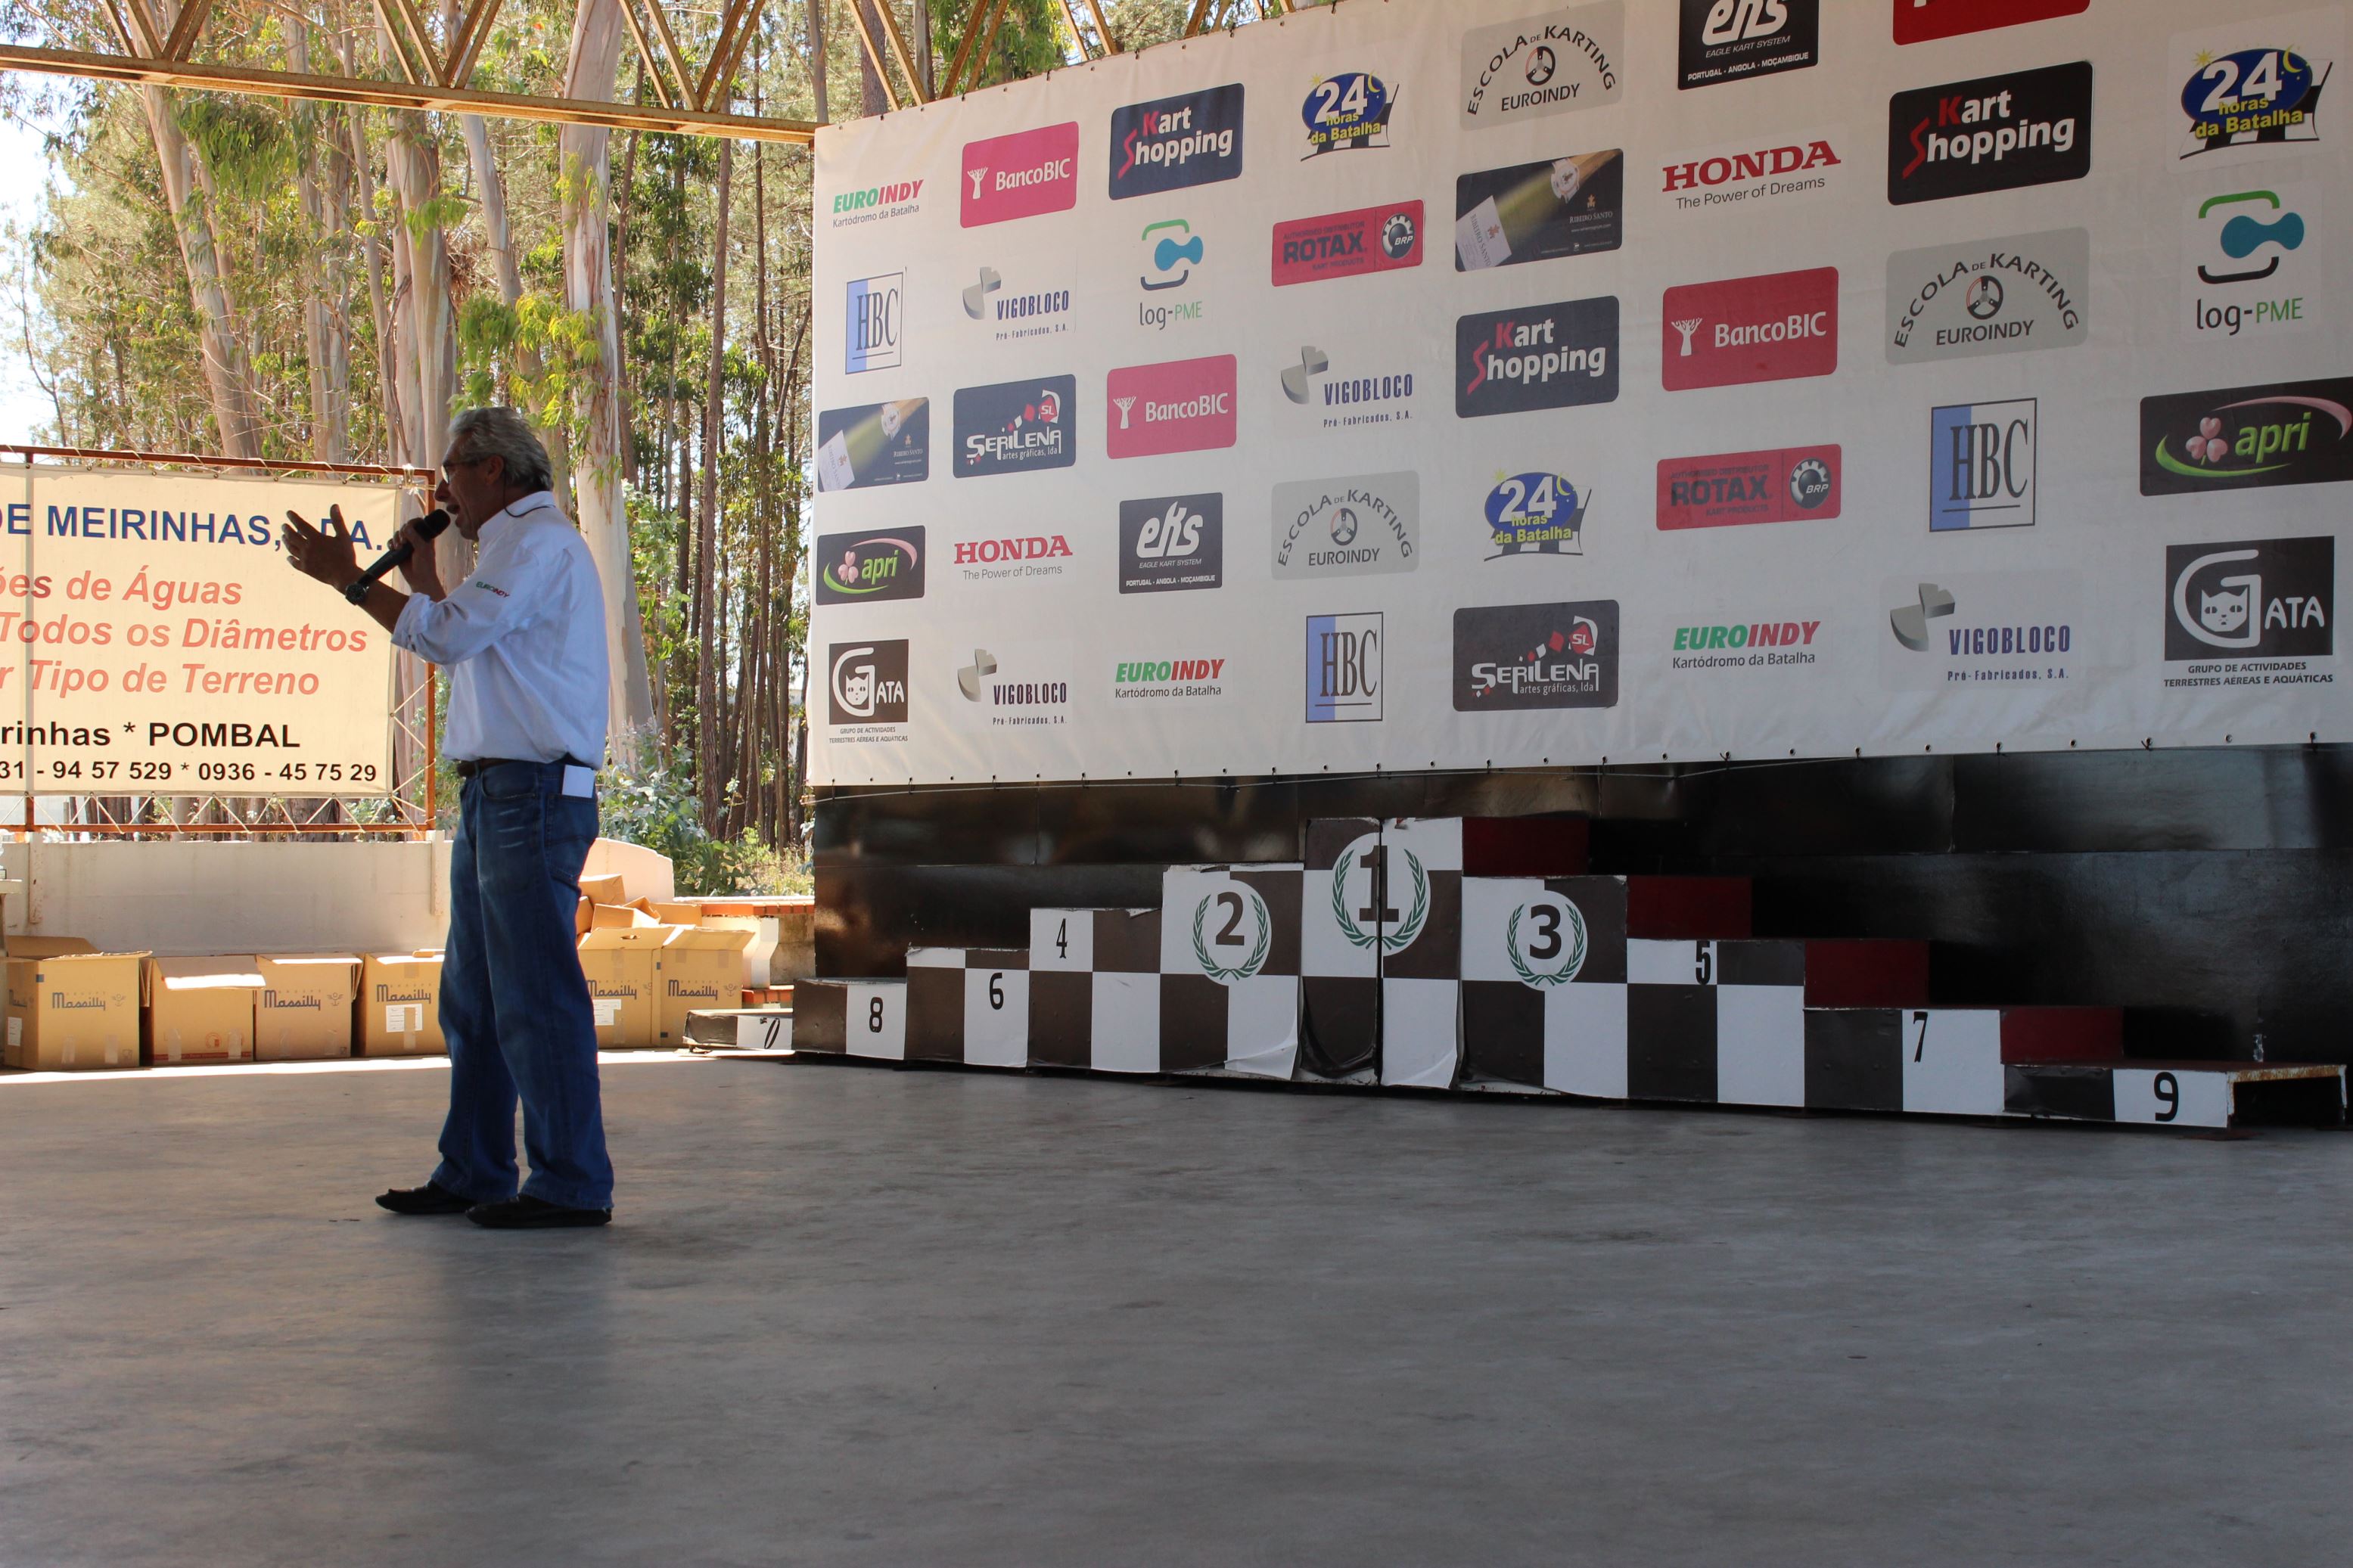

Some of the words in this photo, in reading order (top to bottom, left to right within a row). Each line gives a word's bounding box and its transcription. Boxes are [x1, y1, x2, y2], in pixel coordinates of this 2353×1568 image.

[1706, 47, 1731, 58] EAGLE
[1733, 43, 1754, 53] KART
[1757, 36, 1791, 48] SYSTEM
[1468, 35, 1528, 115] ESCOLA
[1531, 35, 1541, 43] DE
[1544, 25, 1616, 91] KARTING
[1688, 70, 1722, 81] PORTUGAL
[1728, 63, 1755, 73] ANGOLA
[2200, 51, 2282, 112] 24
[1314, 76, 1368, 123] 24
[1501, 83, 1581, 111] EUROINDY
[1938, 89, 2011, 127] Kart
[2218, 98, 2269, 115] horas
[1143, 106, 1192, 136] Kart
[1310, 131, 1326, 144] da
[1331, 121, 1381, 140] Batalha
[1326, 113, 1359, 126] horas
[2196, 121, 2219, 138] da
[2226, 109, 2304, 133] Batalha
[1117, 129, 1233, 179] Shopping
[1902, 117, 2075, 180] Shopping
[996, 158, 1071, 191] BancoBIC
[1663, 140, 1841, 192] HONDA
[833, 179, 925, 214] EUROINDY
[1677, 196, 1701, 210] The
[1704, 188, 1748, 206] Power
[1751, 185, 1766, 198] of
[1770, 176, 1825, 195] Dreams
[832, 212, 877, 228] Kartódromo
[879, 210, 888, 219] da
[891, 203, 919, 216] Batalha
[1283, 231, 1364, 264] ROTAX
[1395, 236, 1413, 245] BRP
[996, 290, 1069, 321] VIGOBLOCO
[1139, 301, 1202, 330] log-PME
[1895, 261, 1969, 348] ESCOLA
[1972, 262, 1986, 271] DE
[1989, 253, 2078, 331] KARTING
[856, 287, 899, 351] HBC
[1714, 312, 1826, 348] BancoBIC
[2196, 297, 2304, 336] log-PME
[1496, 319, 1554, 349] Kart
[1935, 319, 2034, 346] EUROINDY
[1468, 340, 1605, 396] Shopping
[1324, 373, 1413, 405] VIGOBLOCO
[1041, 405, 1054, 415] SL
[1145, 393, 1228, 423] BancoBIC
[2235, 411, 2312, 464] apri
[1002, 452, 1018, 460] artes
[1020, 449, 1046, 460] gráficas,
[1048, 447, 1057, 455] lda
[1949, 418, 2028, 501] HBC
[1499, 476, 1556, 523] 24
[1671, 475, 1769, 506] ROTAX
[1806, 484, 1829, 494] BRP
[48, 506, 280, 551] MEIRINHAS,
[1277, 494, 1332, 567] ESCOLA
[1347, 489, 1413, 558] KARTING
[1512, 514, 1547, 526] horas
[954, 536, 1073, 564] HONDA
[1494, 531, 1512, 545] da
[1516, 526, 1571, 543] Batalha
[861, 549, 899, 585] apri
[963, 570, 978, 580] The
[981, 568, 1010, 581] Power
[1013, 566, 1024, 577] of
[1026, 564, 1062, 577] Dreams
[1308, 548, 1380, 567] EUROINDY
[67, 570, 111, 601] de
[122, 565, 242, 610] Águas
[2174, 549, 2325, 648] GATA
[0, 612, 112, 646] Todos
[127, 622, 170, 647] os
[182, 618, 367, 652] Diâmetros
[1572, 634, 1589, 645] SL
[1674, 621, 1820, 650] EUROINDY
[1949, 625, 2071, 655] VIGOBLOCO
[1115, 660, 1225, 682] EUROINDY
[1320, 629, 1377, 697] HBC
[1672, 654, 1745, 669] Kartódromo
[1749, 654, 1763, 665] da
[1767, 651, 1815, 665] Batalha
[2240, 662, 2306, 671] ACTIVIDADES
[30, 660, 109, 698] Tipo
[123, 663, 167, 692] de
[182, 663, 319, 695] Terreno
[993, 682, 1067, 705] VIGOBLOCO
[1114, 688, 1170, 698] Kartódromo
[1172, 687, 1183, 697] da
[1186, 685, 1221, 696] Batalha
[1543, 683, 1578, 695] gráficas,
[1581, 682, 1593, 692] lda
[2164, 678, 2221, 687] TERRESTRES
[2224, 675, 2261, 685] AÉREAS
[2273, 673, 2333, 683] AQUÁTICAS
[2, 721, 110, 746] rinhas
[149, 722, 300, 747] POMBAL
[53, 761, 82, 778] 94
[92, 761, 119, 778] 57
[129, 762, 171, 780] 529
[198, 763, 255, 781] 0936
[279, 763, 306, 781] 45
[315, 763, 342, 781] 75
[350, 764, 377, 782] 29
[1358, 845, 1400, 922] 1
[1215, 890, 1245, 946] 2
[1528, 904, 1562, 960] 3
[1056, 918, 1067, 959] 4
[1695, 942, 1711, 985] 5
[52, 992, 106, 1011] Massilly
[264, 990, 321, 1011] Massilly
[377, 984, 431, 1004] Massilly
[586, 980, 636, 999] Massilly
[668, 980, 718, 1000] Massilly
[989, 972, 1003, 1011] 6
[869, 996, 883, 1032] 8
[1913, 1011, 1929, 1063] 7
[2153, 1071, 2178, 1122] 9
